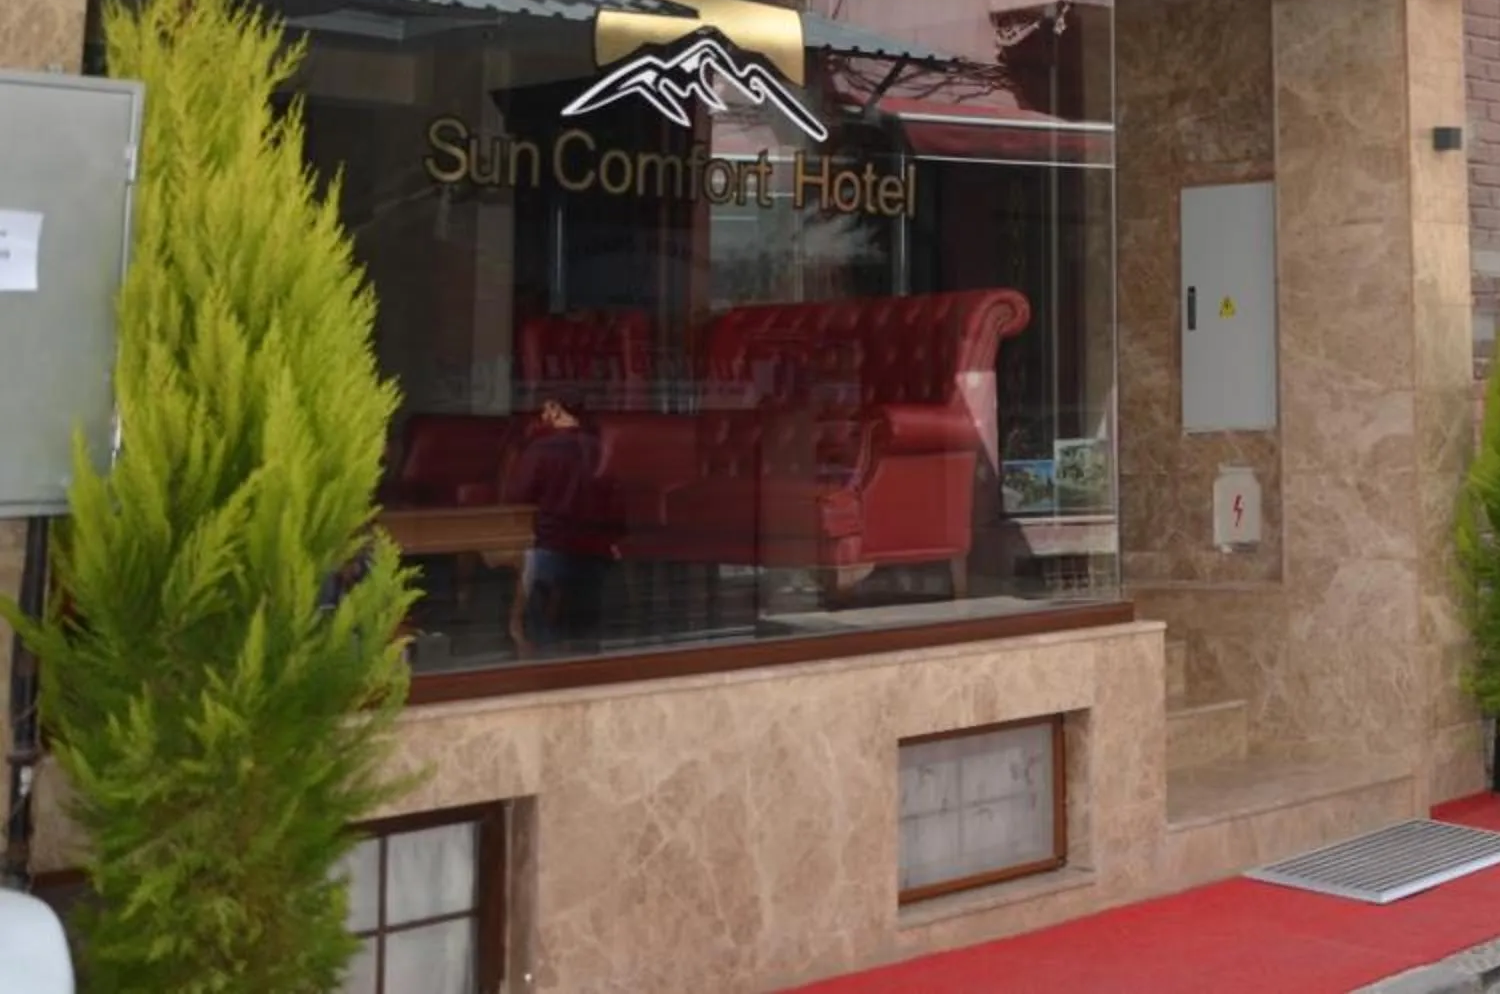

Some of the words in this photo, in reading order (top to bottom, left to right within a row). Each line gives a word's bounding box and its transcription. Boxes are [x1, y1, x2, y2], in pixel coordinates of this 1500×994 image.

[424, 117, 540, 189] Sun
[552, 128, 773, 207] Comfort
[794, 148, 917, 219] Hotel
